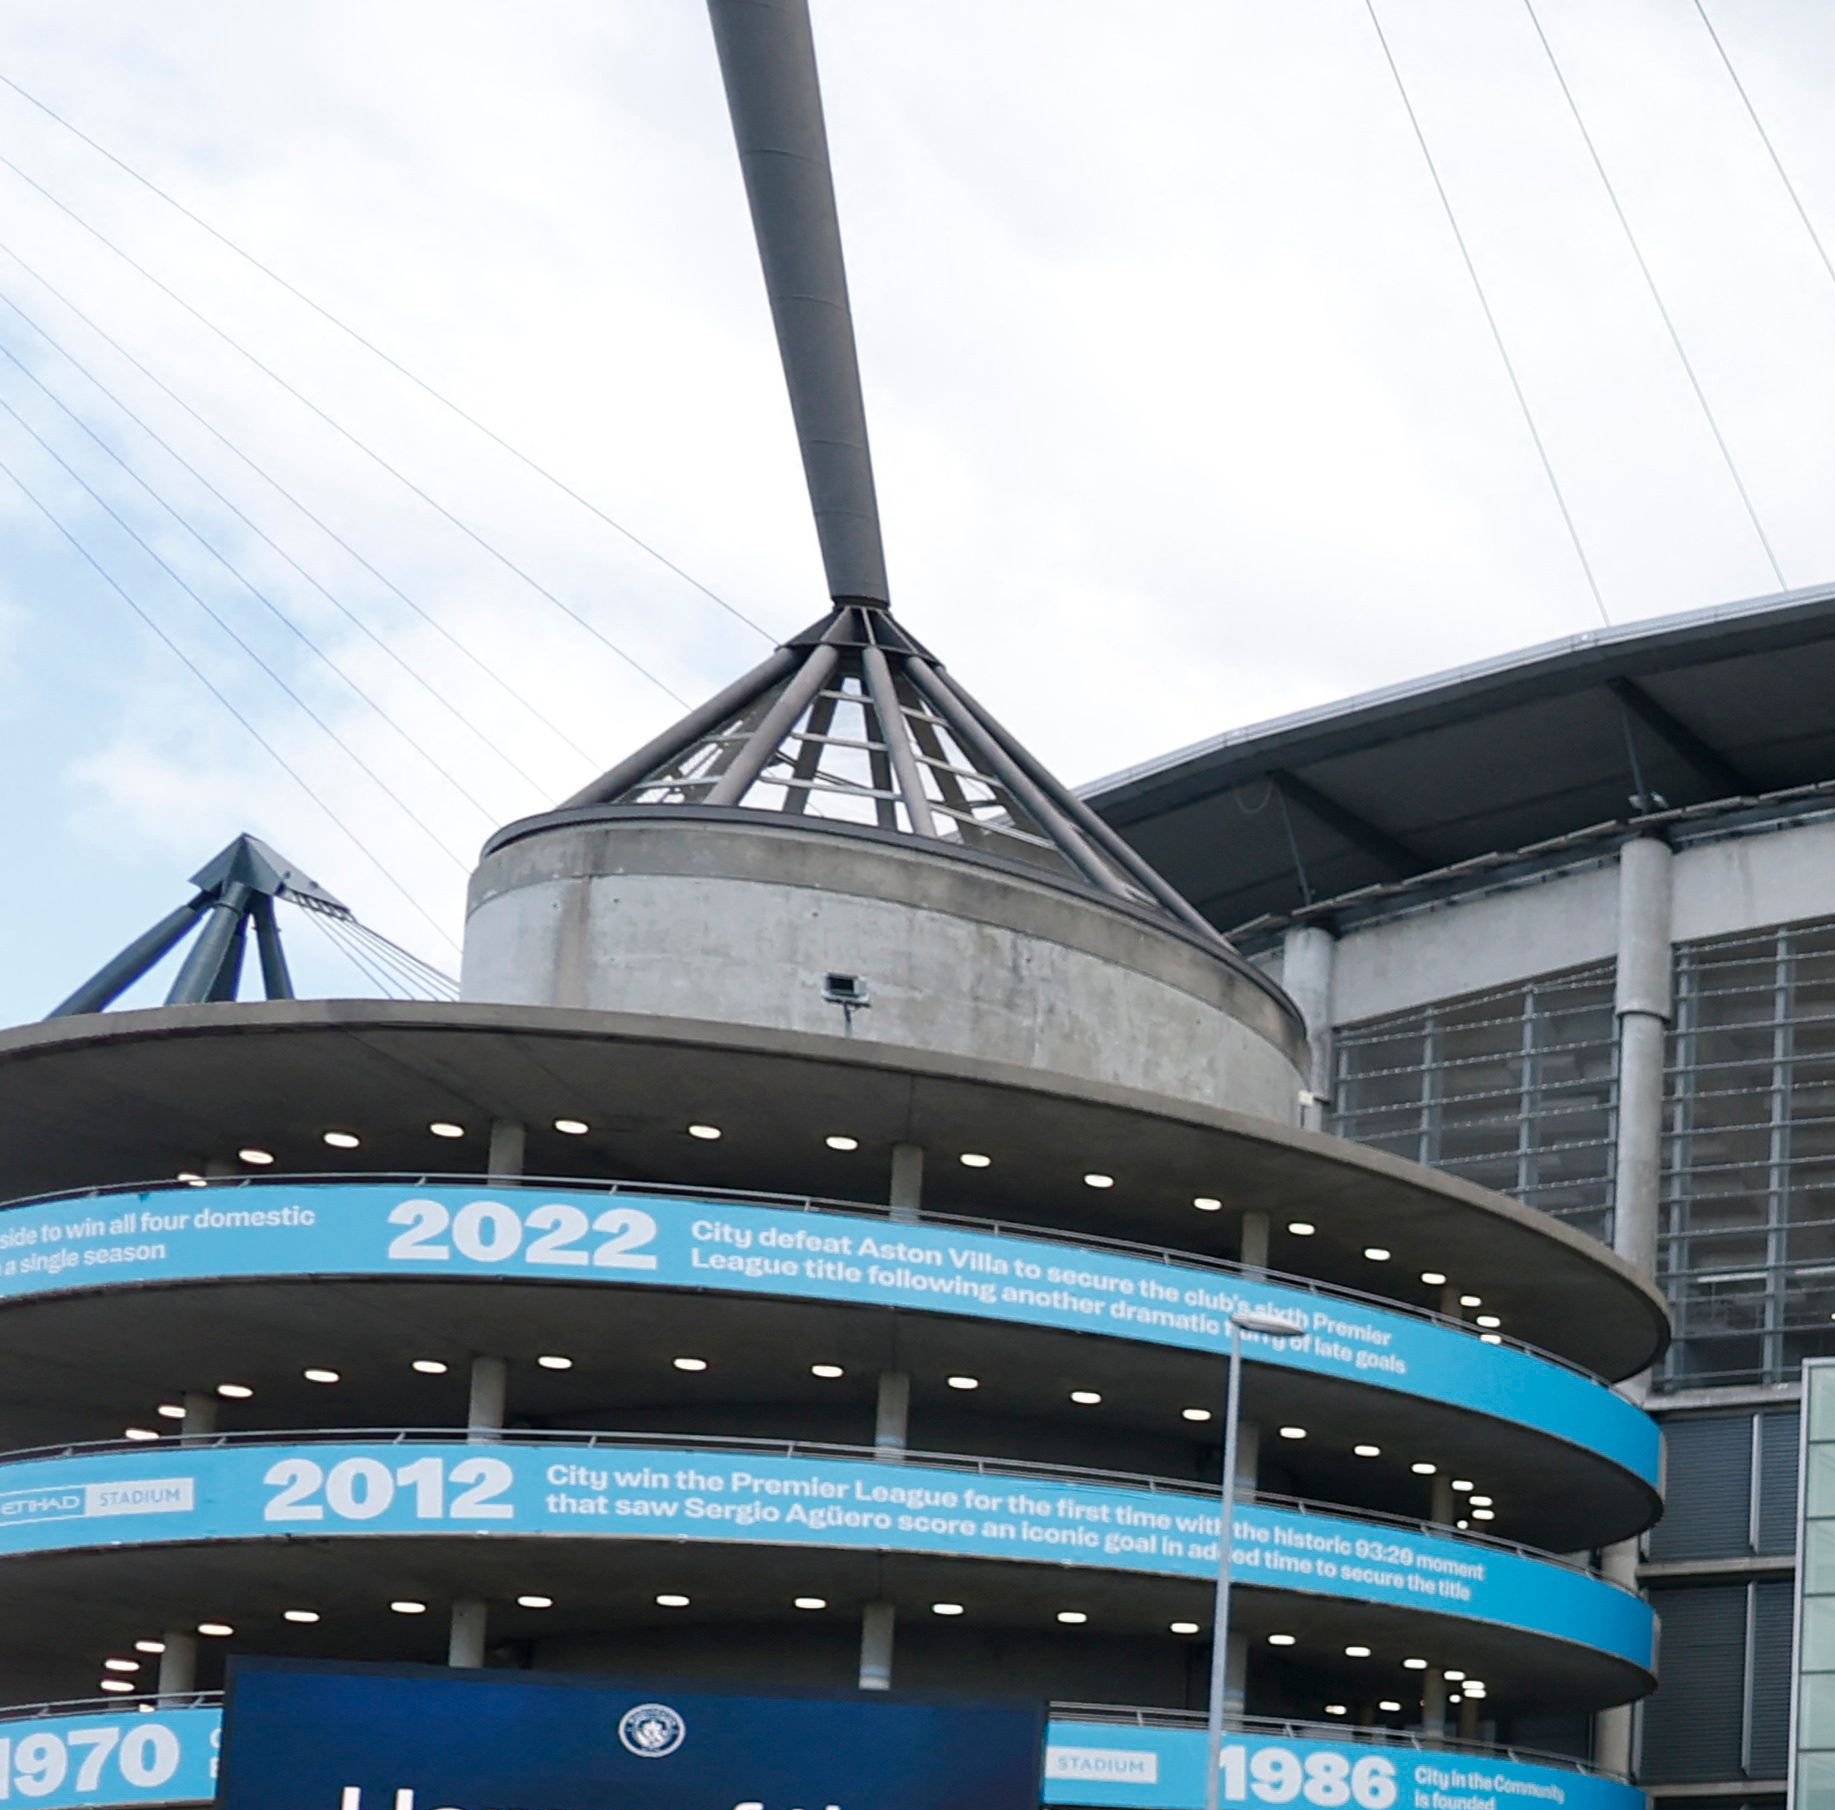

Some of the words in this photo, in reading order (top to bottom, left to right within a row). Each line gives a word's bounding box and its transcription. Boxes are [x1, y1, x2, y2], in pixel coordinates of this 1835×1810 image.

[0, 1228, 37, 1249] side
[41, 1224, 61, 1242] to
[66, 1218, 105, 1239] win
[110, 1214, 136, 1235] all
[141, 1211, 189, 1232] four
[194, 1206, 315, 1230] domestic
[387, 1198, 659, 1271] 2022
[5, 1260, 16, 1276] a
[21, 1250, 78, 1274] single
[84, 1243, 165, 1265] season
[692, 1219, 753, 1249] City
[759, 1230, 852, 1256] defeat
[858, 1237, 942, 1266] Aston
[948, 1248, 1009, 1276] Villa
[1014, 1258, 1041, 1281] to
[1048, 1263, 1135, 1296] secure
[1140, 1279, 1180, 1302] the
[1184, 1288, 1250, 1315] club's
[1313, 1310, 1392, 1347] Premier
[692, 1248, 798, 1278] League
[805, 1258, 861, 1283] title
[867, 1266, 998, 1303] following
[1002, 1285, 1105, 1316] another
[1110, 1301, 1219, 1335] dramatic
[1315, 1336, 1352, 1362] late
[1355, 1349, 1408, 1374] goals
[100, 1487, 181, 1507] STADIUM
[263, 1457, 514, 1521] 2012
[546, 1463, 608, 1492] City
[615, 1467, 669, 1491] win
[675, 1469, 724, 1492] the
[732, 1472, 849, 1500] Premier
[855, 1480, 959, 1510] League
[965, 1489, 1003, 1513] for
[1008, 1495, 1052, 1517] the
[1057, 1500, 1109, 1524] first
[1116, 1506, 1171, 1531] time
[1233, 1522, 1270, 1546] the
[1274, 1527, 1351, 1557] historic
[1416, 1553, 1485, 1581] moment
[546, 1493, 609, 1514] that
[615, 1499, 678, 1517] saw
[685, 1497, 780, 1526] Sergio
[785, 1501, 891, 1530] Agüero
[898, 1514, 976, 1537] score
[982, 1521, 1016, 1540] an
[1021, 1521, 1100, 1548] iconic
[1104, 1530, 1157, 1555] goal
[1162, 1536, 1184, 1557] in
[1264, 1549, 1312, 1574] time
[1316, 1559, 1336, 1579] to
[1340, 1564, 1403, 1588] secure
[1407, 1571, 1434, 1593] the
[1438, 1577, 1471, 1601] title
[1056, 1755, 1145, 1775] STADIUM
[1414, 1766, 1450, 1791] City
[1451, 1768, 1466, 1788] in
[1467, 1769, 1493, 1792] the
[1494, 1772, 1565, 1805] Community
[1414, 1790, 1431, 1809] is
